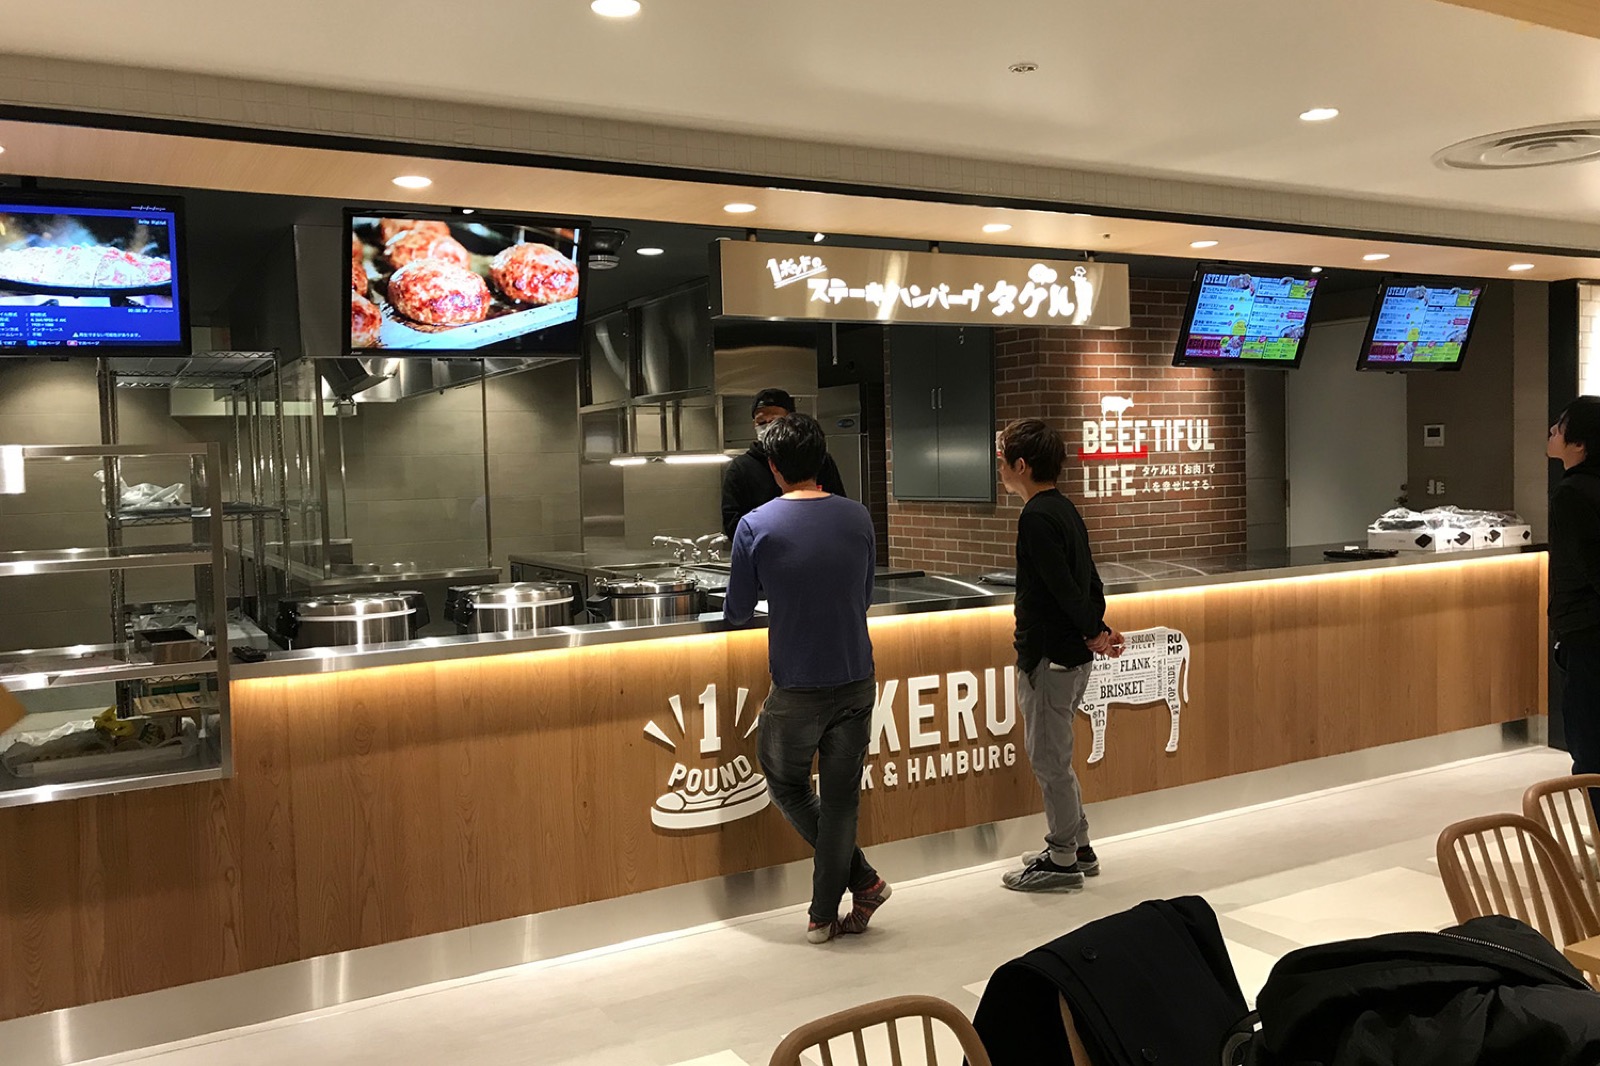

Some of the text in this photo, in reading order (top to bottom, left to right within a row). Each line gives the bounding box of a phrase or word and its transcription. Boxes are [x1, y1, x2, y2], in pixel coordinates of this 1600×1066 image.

[1083, 419, 1215, 453] BEEFTIFUL
[1142, 464, 1215, 476] タケルは「お肉」で
[1083, 464, 1136, 498] LIFE
[1142, 479, 1215, 493] 人を幸せにする。
[1131, 633, 1156, 644] SIRLOIN
[1131, 642, 1156, 650] FILLET
[1120, 657, 1151, 672] FLANK
[1167, 665, 1176, 685] SIDE
[1100, 680, 1145, 699] BRISKET
[1167, 687, 1176, 703] TOP
[699, 683, 722, 753] 1
[868, 665, 1017, 755] KERU
[667, 755, 752, 792] POUND
[883, 761, 899, 787] &
[907, 742, 1017, 784] HAMBURG
